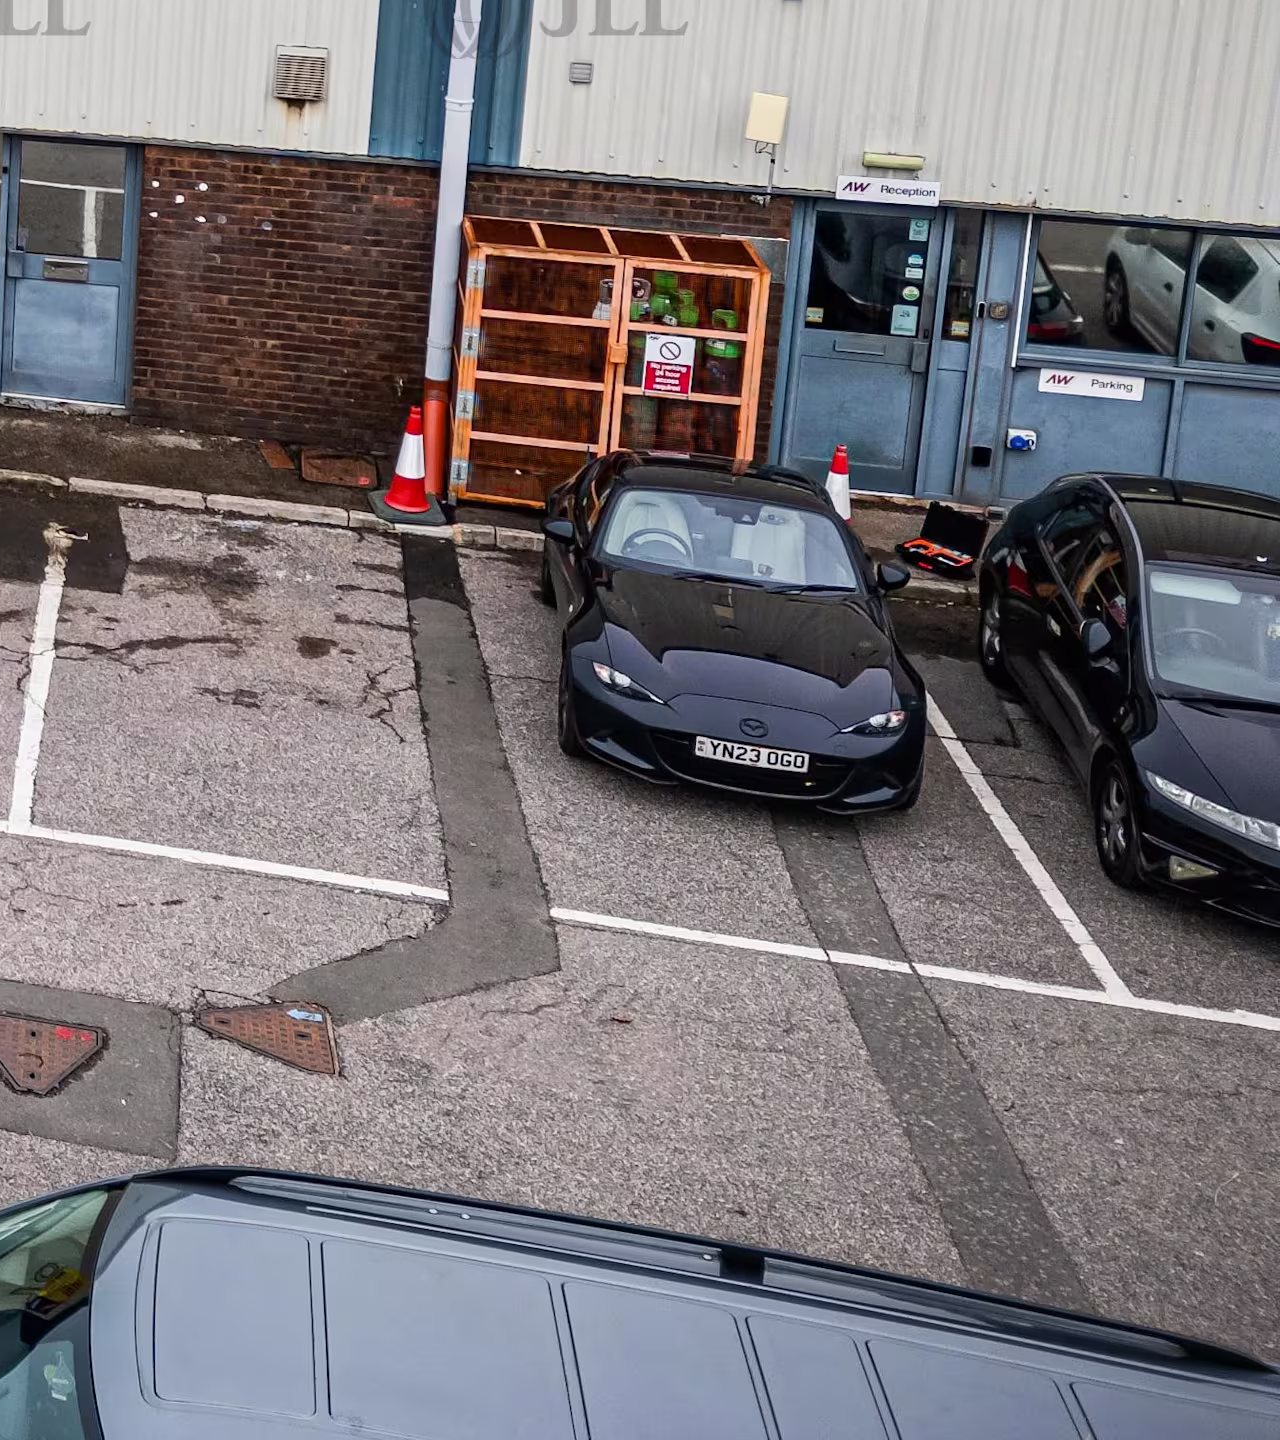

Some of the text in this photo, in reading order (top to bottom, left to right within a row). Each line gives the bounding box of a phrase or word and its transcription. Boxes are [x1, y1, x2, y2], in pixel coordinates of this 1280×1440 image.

[880, 184, 936, 198] Reception
[661, 364, 688, 373] parking
[1090, 379, 1134, 393] Parking
[710, 740, 761, 763] YN23
